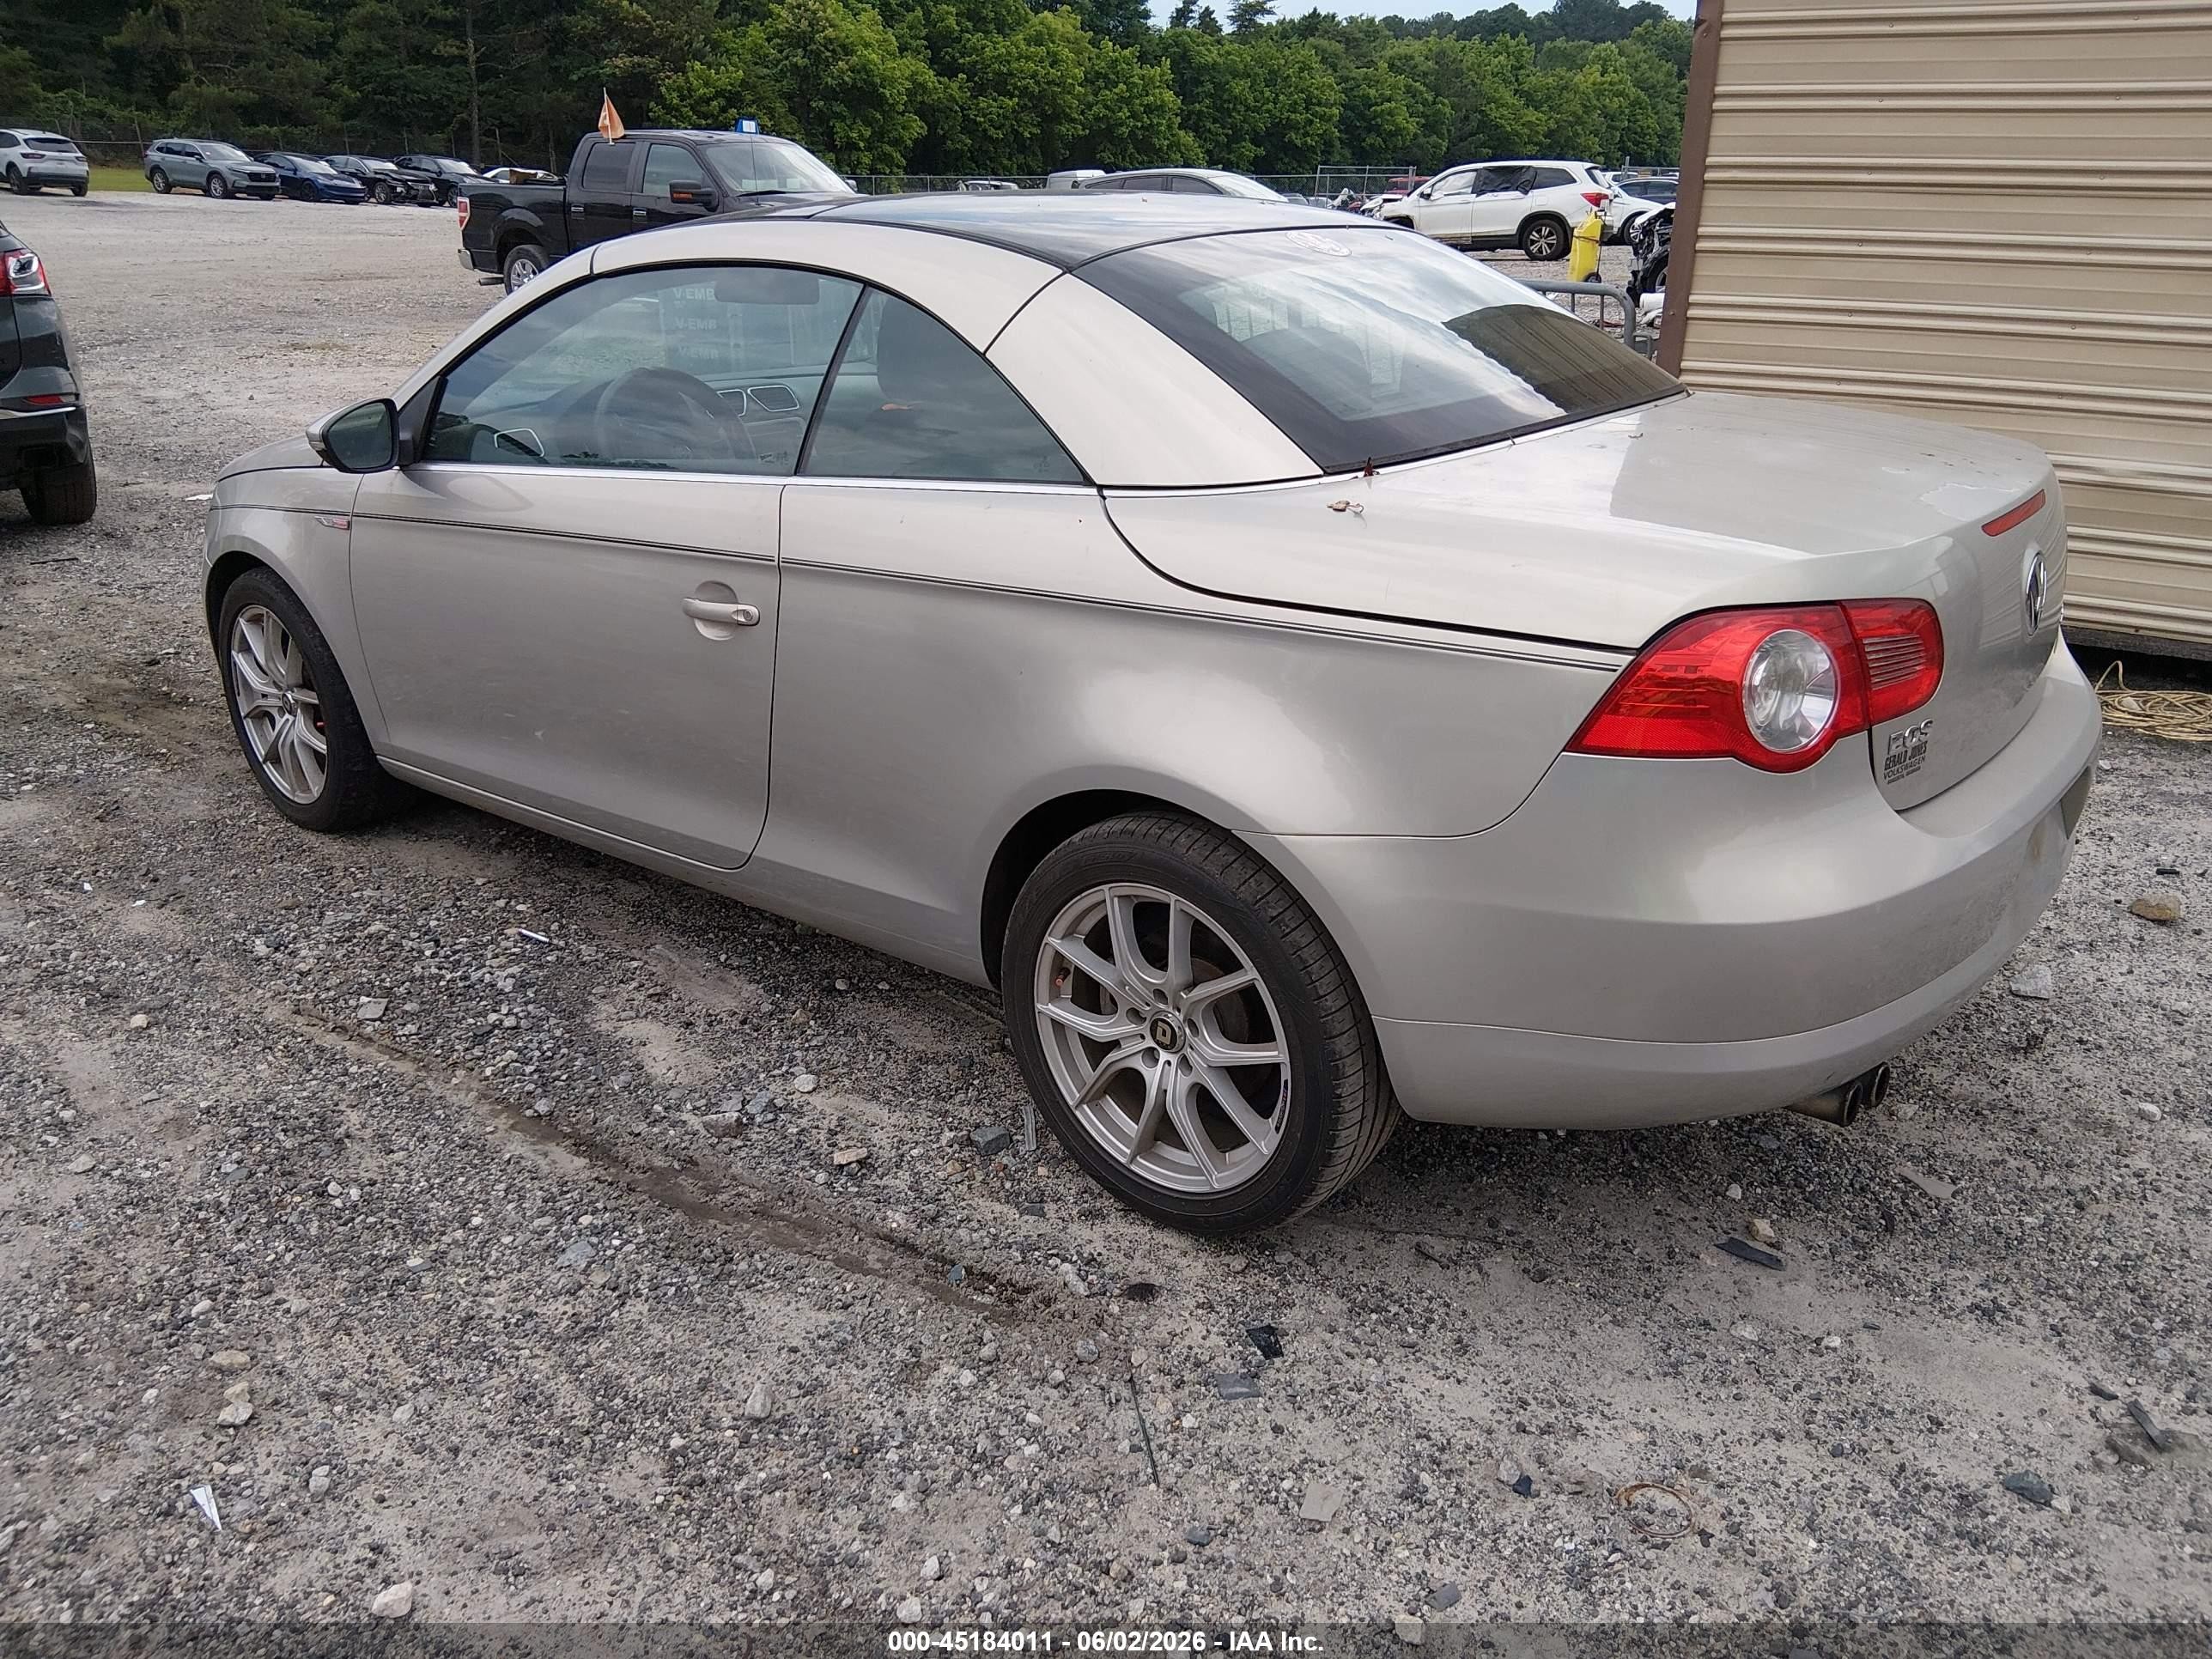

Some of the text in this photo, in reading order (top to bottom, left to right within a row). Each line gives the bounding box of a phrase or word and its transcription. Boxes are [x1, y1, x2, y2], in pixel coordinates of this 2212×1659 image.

[1883, 755, 1926, 781] VOLKSWAGEN
[1884, 740, 1929, 770] GERALD JONES
